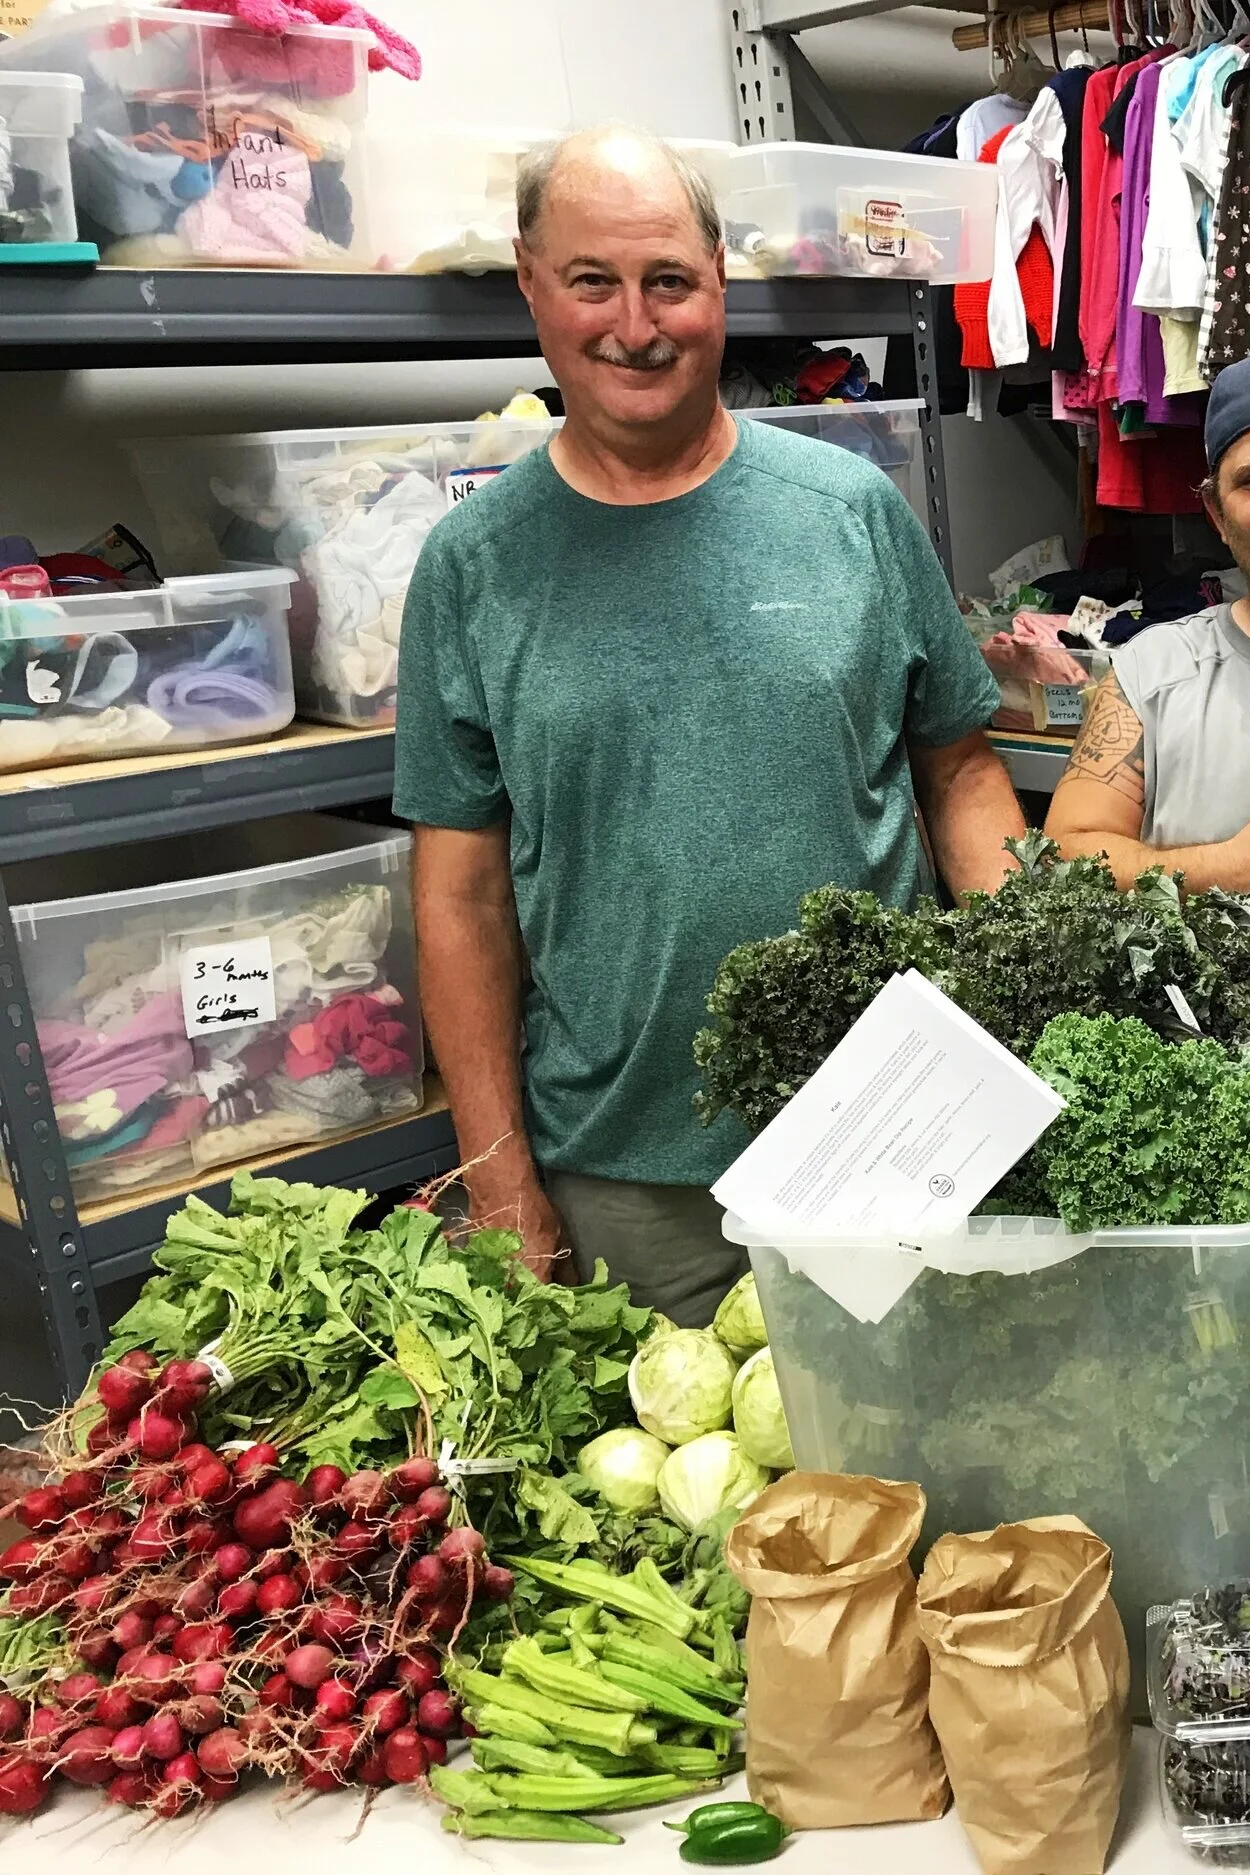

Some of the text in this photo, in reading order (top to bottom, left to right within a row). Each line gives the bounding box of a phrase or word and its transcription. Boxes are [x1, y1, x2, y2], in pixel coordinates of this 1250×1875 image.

[206, 104, 284, 154] Infant
[231, 158, 287, 191] Hats
[196, 993, 237, 1011] Girls
